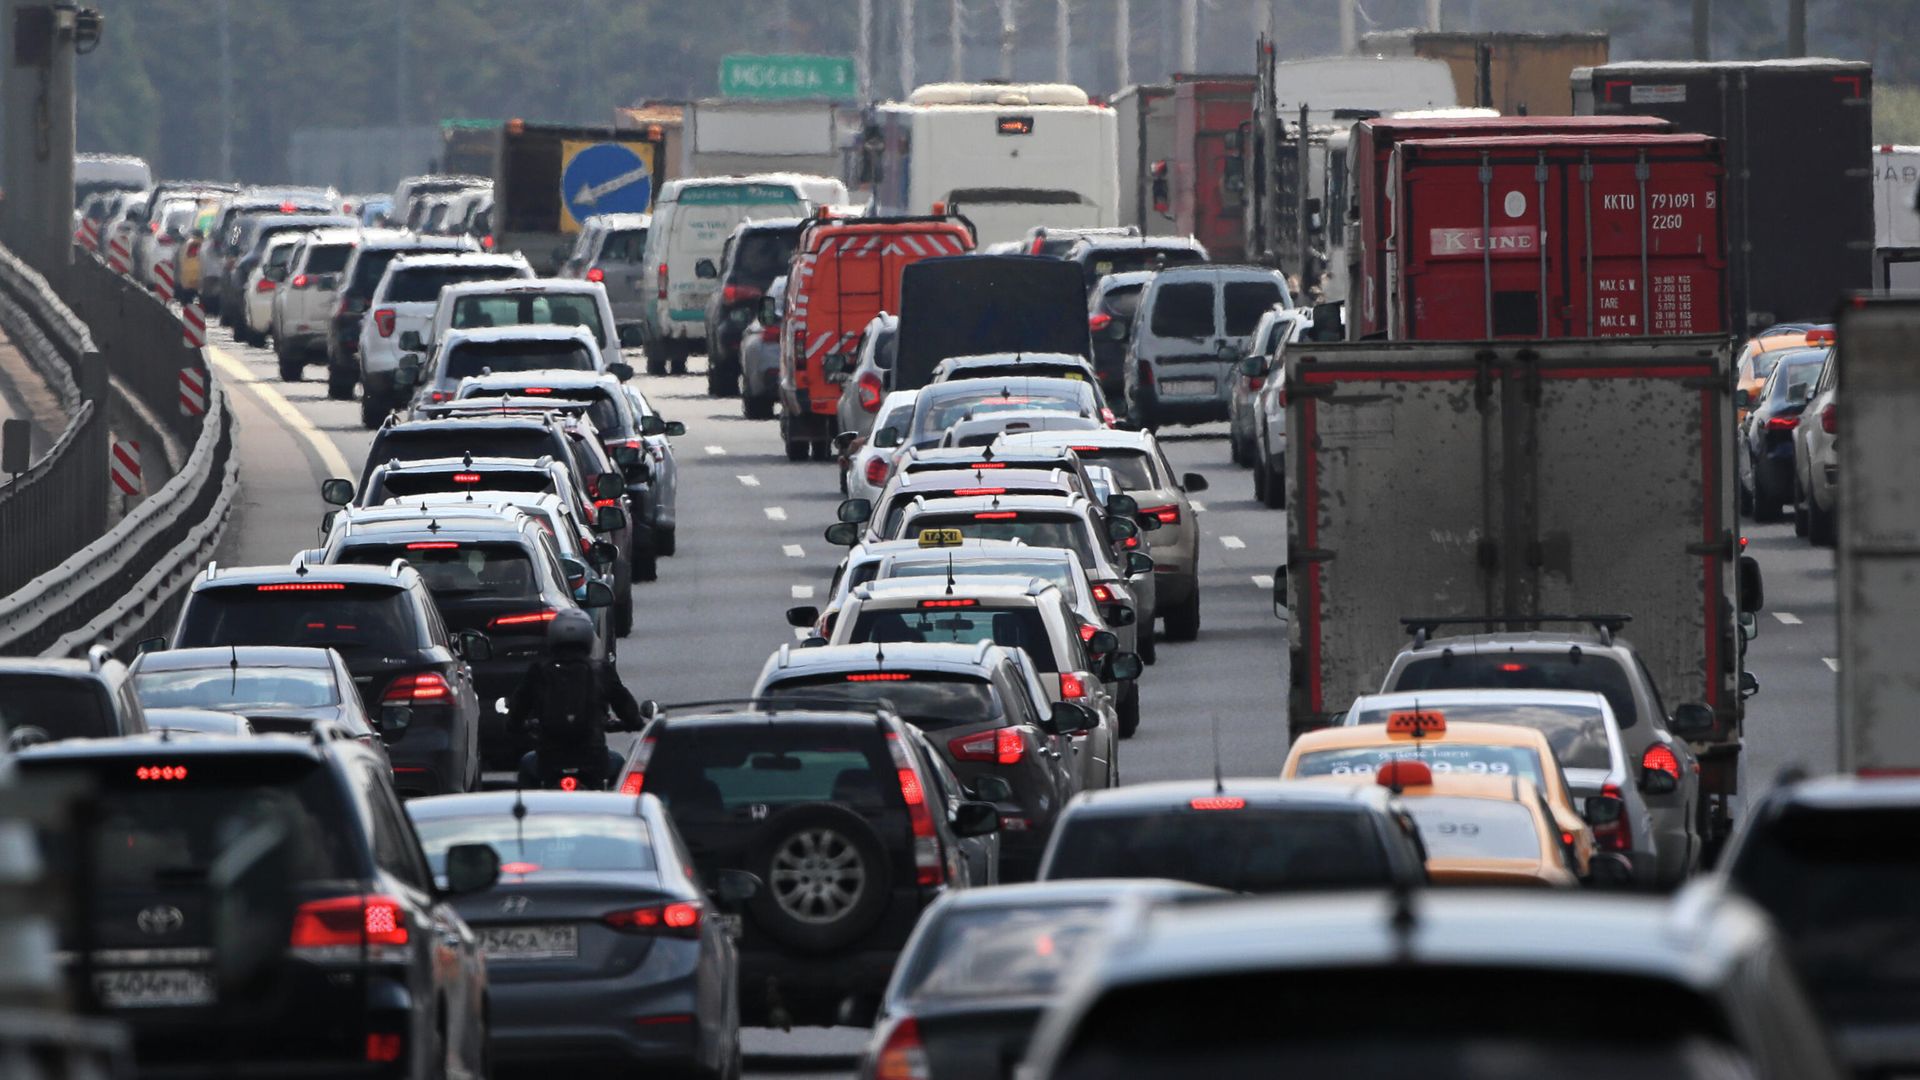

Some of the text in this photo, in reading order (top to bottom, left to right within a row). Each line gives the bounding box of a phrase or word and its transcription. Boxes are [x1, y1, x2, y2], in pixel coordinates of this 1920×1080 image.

[1604, 194, 1635, 210] KKTU
[1651, 193, 1695, 209] 791091
[1600, 297, 1619, 309] TARE
[925, 531, 956, 541] TAXI
